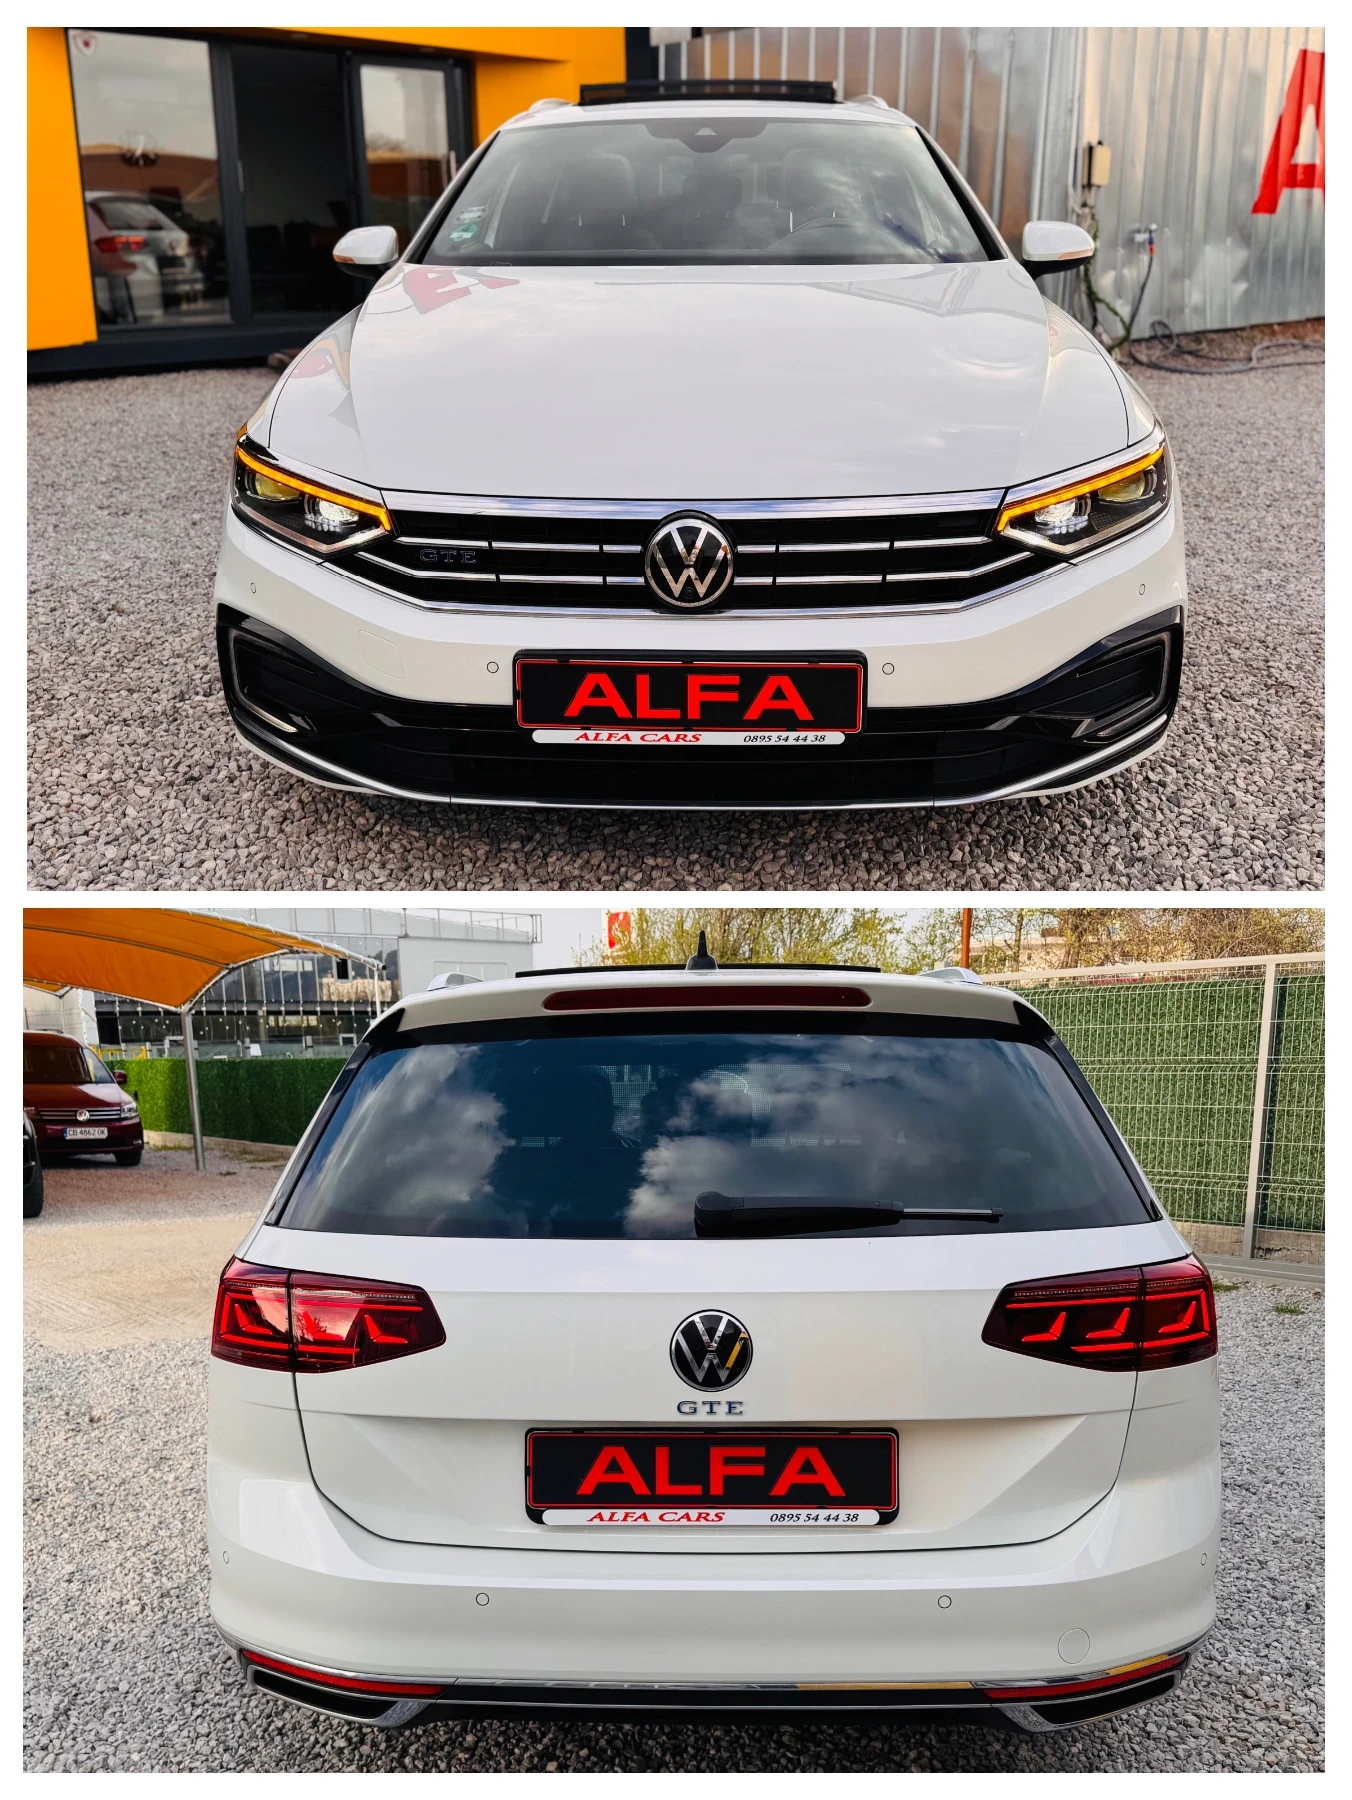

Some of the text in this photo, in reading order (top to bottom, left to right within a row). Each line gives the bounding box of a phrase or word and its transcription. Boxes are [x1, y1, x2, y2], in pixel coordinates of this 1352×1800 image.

[420, 549, 476, 563] GTE
[564, 671, 815, 721] ALFA
[574, 732, 702, 743] ALFA CARS
[743, 734, 826, 743] 0895 54 44 38
[677, 1401, 743, 1415] GTE
[576, 1445, 846, 1496] ALFA
[587, 1512, 725, 1522] ALFA CARS
[770, 1513, 859, 1523] 0895 54 44 38
